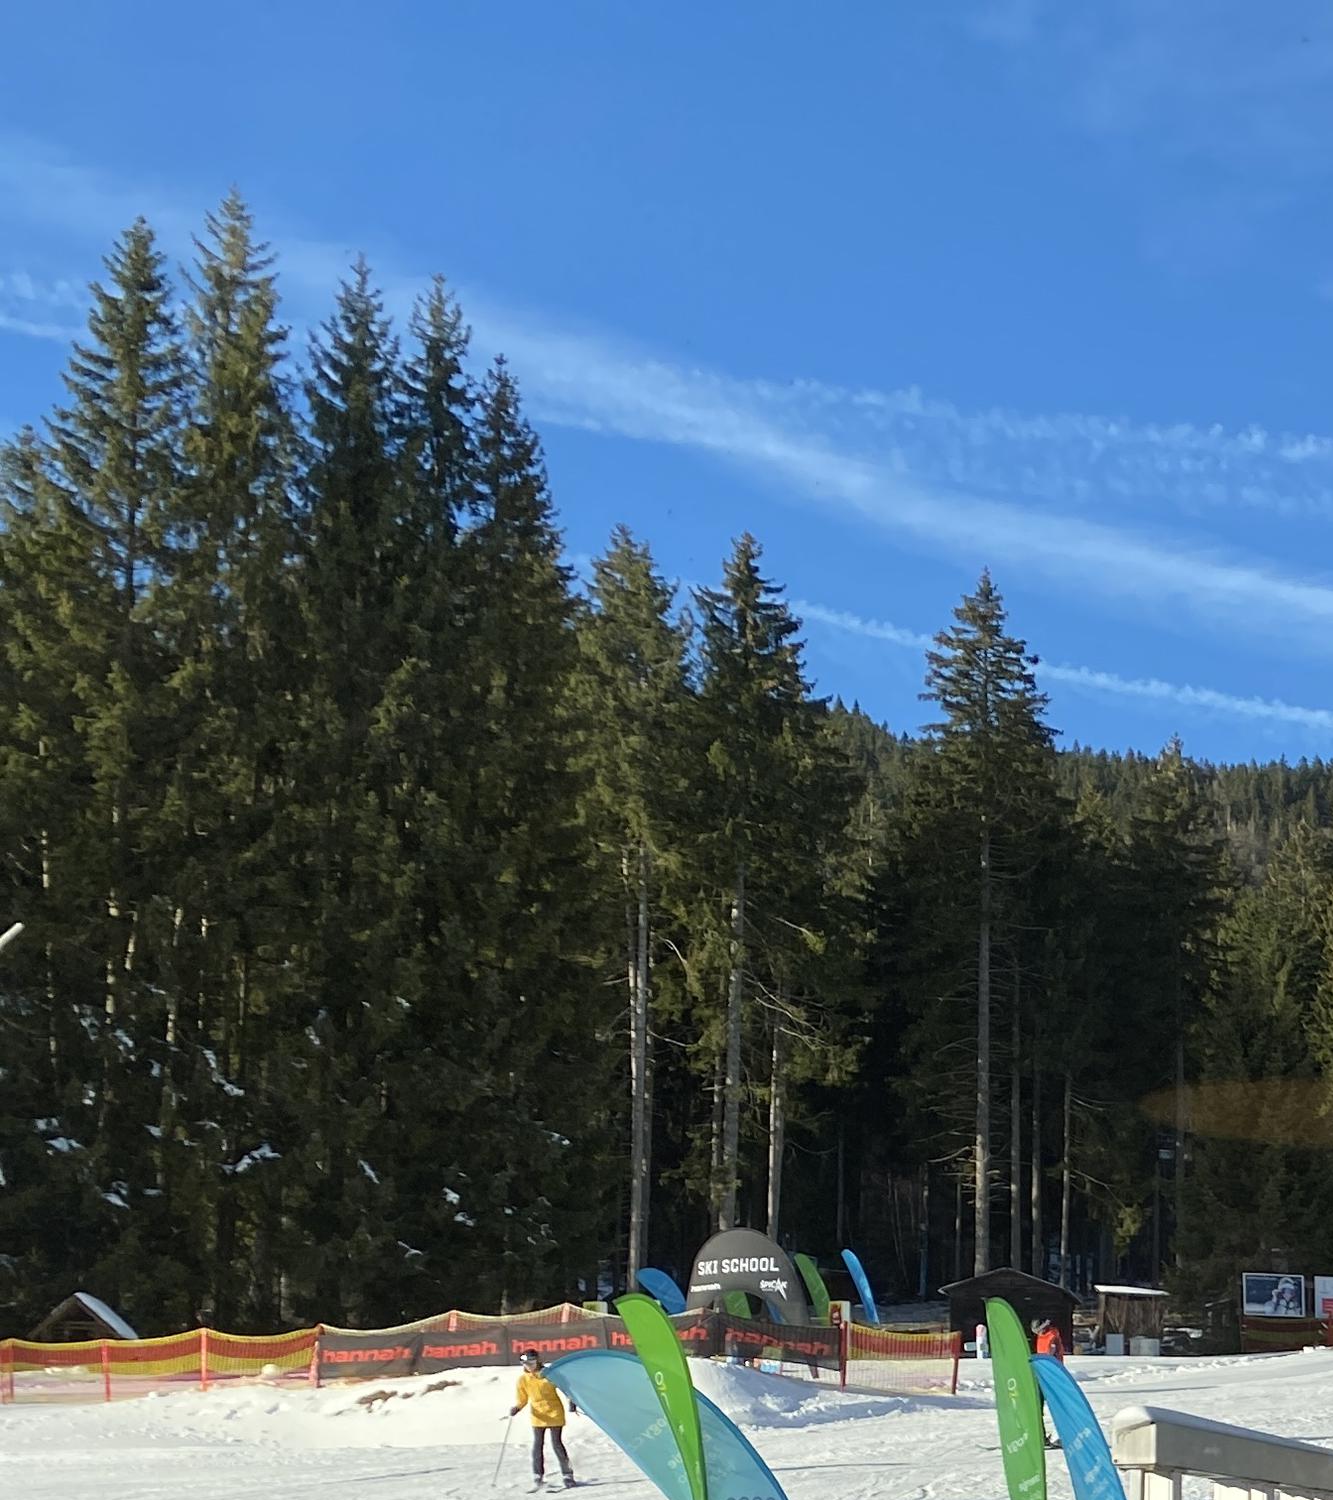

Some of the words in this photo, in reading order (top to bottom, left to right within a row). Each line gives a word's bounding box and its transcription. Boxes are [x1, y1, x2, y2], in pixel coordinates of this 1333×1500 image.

[697, 1260, 719, 1276] SKI
[721, 1257, 780, 1273] SCHOOL
[421, 1341, 498, 1358] hannah
[511, 1334, 598, 1354] hannah
[322, 1346, 411, 1363] hannah
